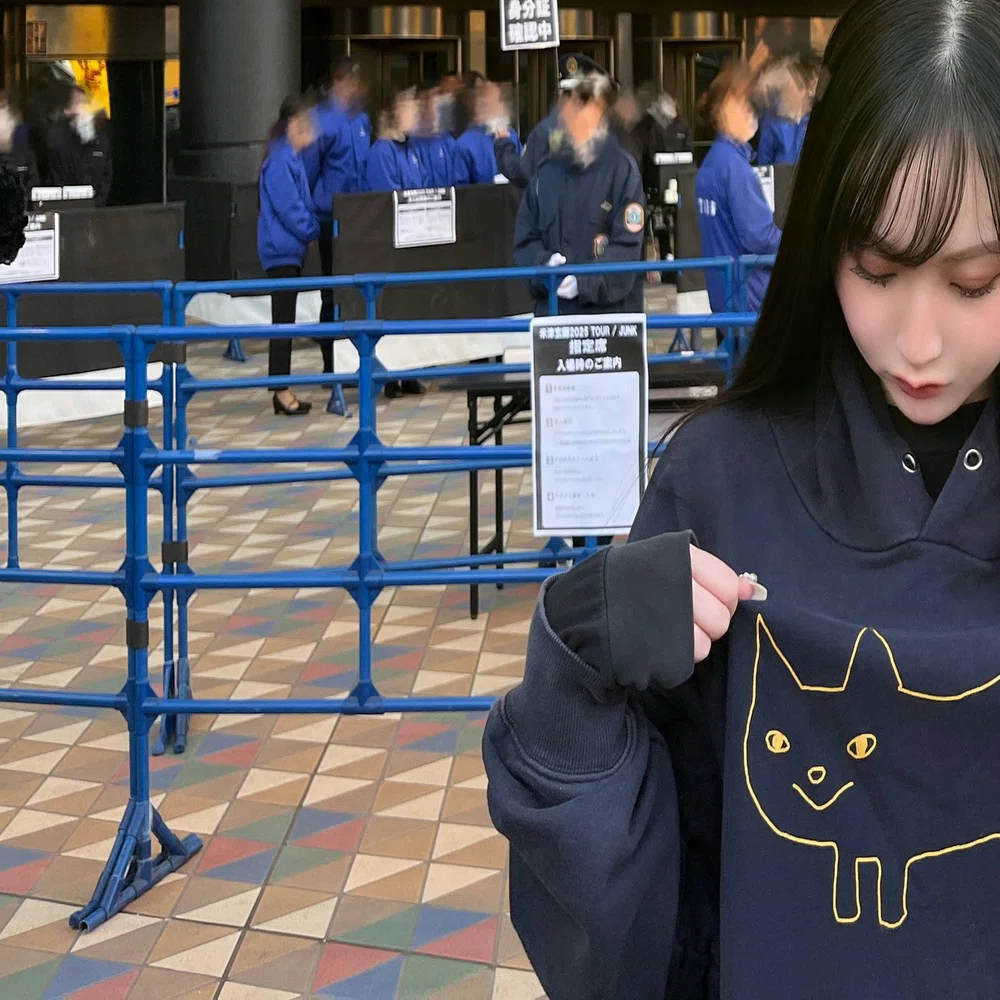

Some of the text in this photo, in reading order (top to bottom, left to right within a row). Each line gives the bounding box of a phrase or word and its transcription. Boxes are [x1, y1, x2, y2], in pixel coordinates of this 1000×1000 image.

[508, 20, 552, 43] 確認中
[591, 325, 611, 337] TOUR
[618, 324, 638, 337] JUNK
[569, 338, 608, 355] 指定席
